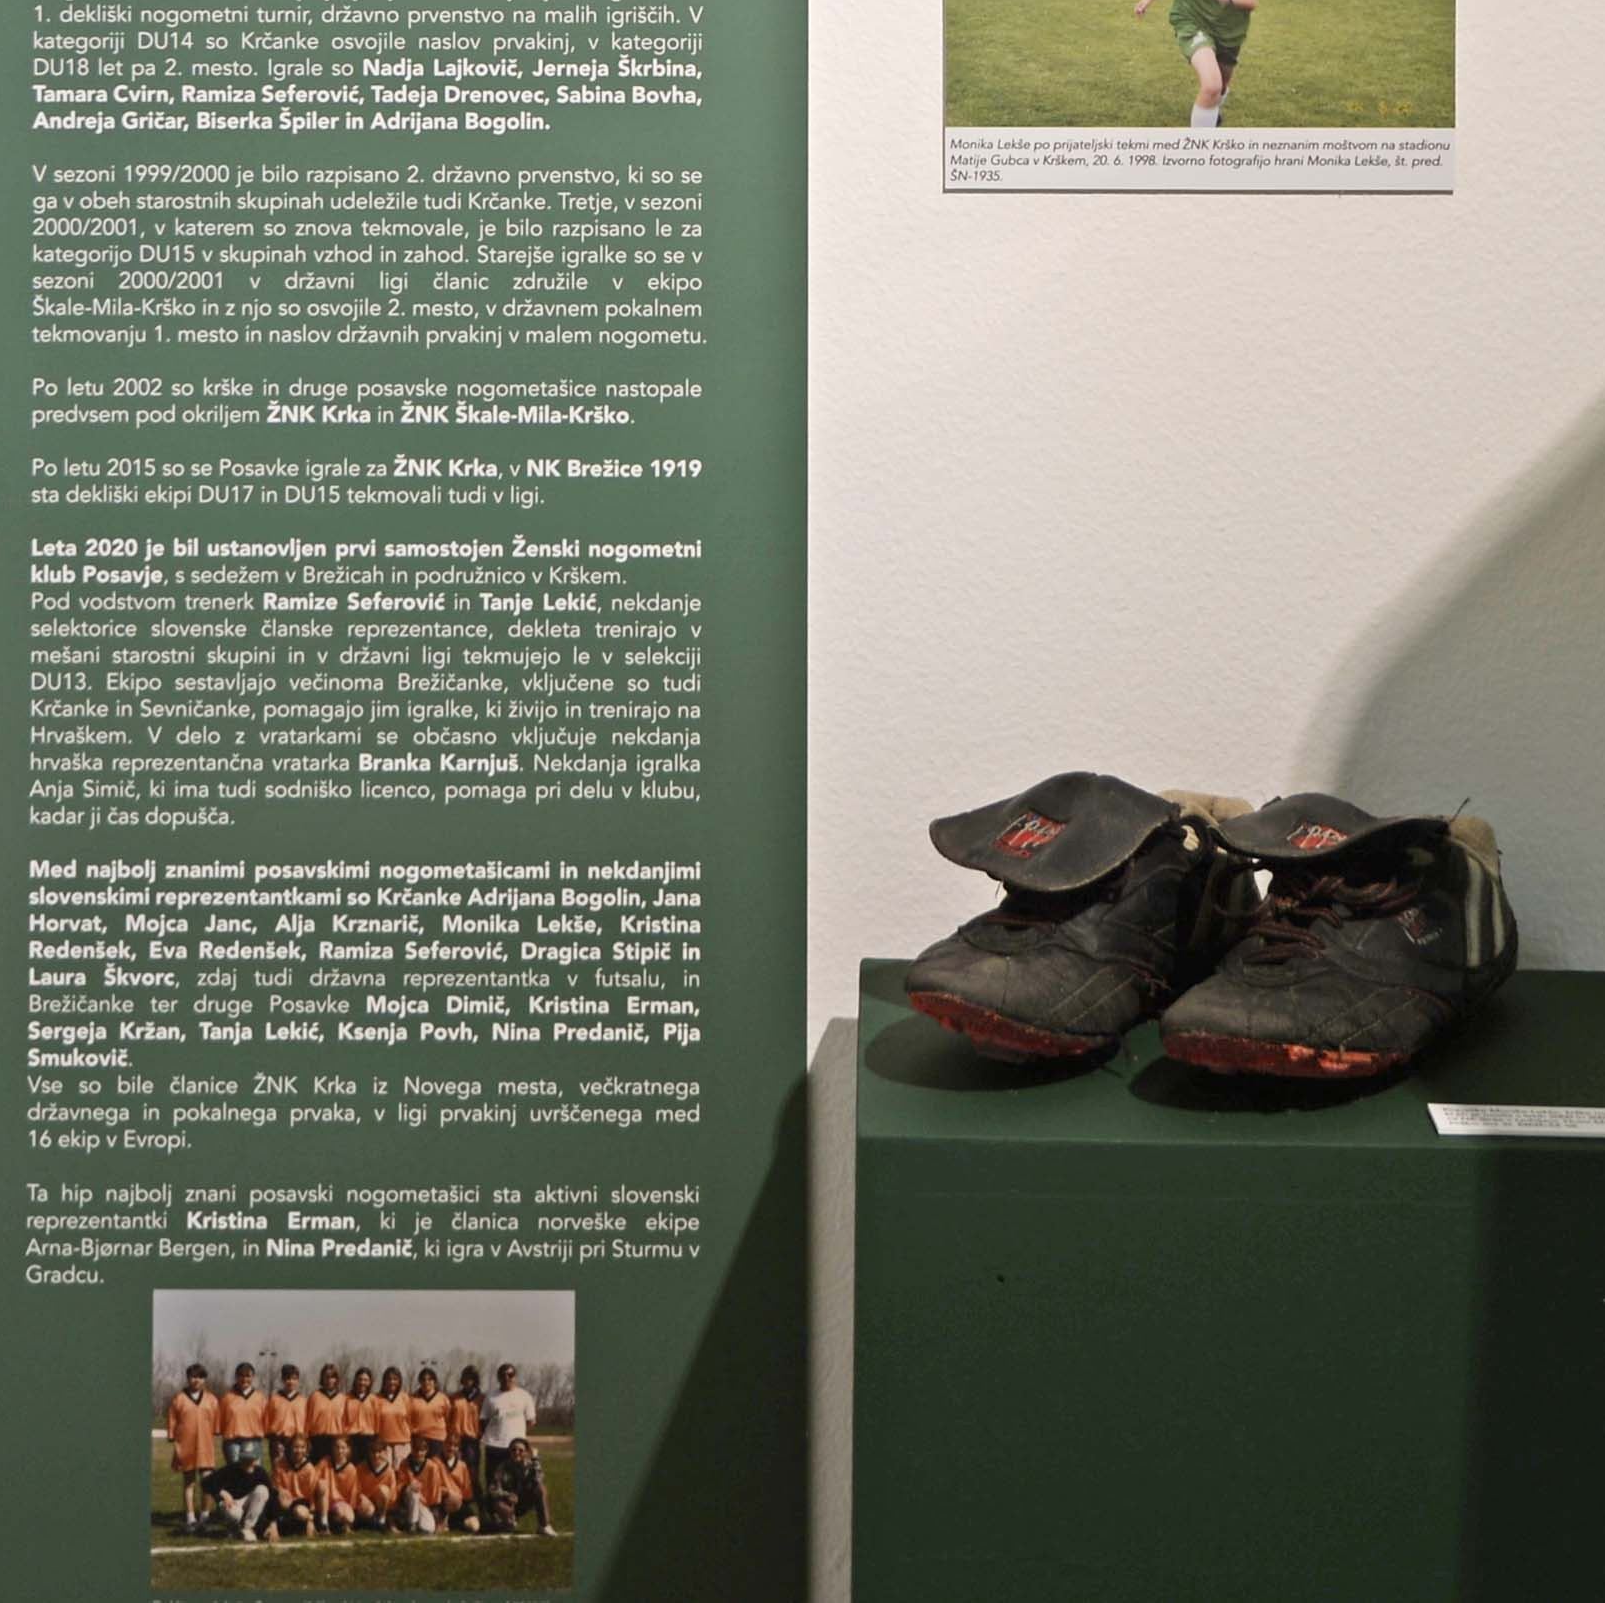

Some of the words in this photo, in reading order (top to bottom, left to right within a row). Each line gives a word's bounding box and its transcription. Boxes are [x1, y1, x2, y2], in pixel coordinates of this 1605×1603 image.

[949, 138, 994, 150] Monika
[997, 138, 1031, 150] Lekše
[1033, 141, 1051, 153] po
[1052, 137, 1114, 153] prijateljski
[1116, 138, 1150, 151] tekmi
[1152, 138, 1181, 151] med
[1182, 136, 1210, 151] ŽNK
[1211, 138, 1246, 151] Krško
[1247, 140, 1260, 151] in
[1261, 139, 1320, 151] neznanim
[1322, 139, 1378, 151] moštvom
[1380, 141, 1396, 151] na
[1397, 138, 1451, 151] stadionu
[949, 154, 988, 170] Matije
[990, 154, 1030, 166] Gubca
[1033, 157, 1040, 166] v
[1162, 154, 1206, 167] Izvorno
[1208, 153, 1272, 170] fotografijo
[1273, 154, 1305, 167] hrani
[1306, 154, 1352, 167] Monika
[32, 457, 58, 477] Po
[64, 457, 101, 477] letu
[106, 457, 156, 477] 2015
[162, 463, 185, 477] so
[190, 463, 213, 477] se
[219, 457, 300, 477] Posavke
[305, 457, 361, 481] igrale
[366, 463, 387, 477] za
[393, 454, 443, 477] ŽNK
[448, 457, 503, 480] Krka,
[509, 464, 521, 477] v
[526, 458, 562, 478] NK
[567, 458, 644, 478] Brežice
[650, 458, 703, 478] 1919
[31, 537, 77, 557] Leta
[84, 537, 139, 557] 2020
[144, 537, 165, 562] je
[173, 537, 199, 557] bil
[206, 537, 327, 563] ustanovljen
[335, 538, 377, 562] prvi
[384, 538, 504, 563] samostojen
[511, 534, 580, 558] Ženski
[588, 539, 702, 564] nogometni
[28, 913, 108, 935] Horvat,
[125, 913, 189, 938] Mojca
[204, 913, 258, 935] Janc,
[274, 912, 316, 938] Alja
[332, 913, 425, 936] Krznarič,
[442, 913, 520, 934] Monika
[536, 913, 603, 936] Lekše,
[620, 914, 701, 934] Kristina
[25, 1237, 154, 1262] Arna-Bjørnar
[158, 1237, 236, 1263] Bergen,
[242, 1238, 260, 1257] in
[266, 1237, 316, 1258] Nina
[321, 1237, 418, 1260] Predanič,
[424, 1237, 440, 1257] ki
[447, 1239, 484, 1263] igra
[490, 1244, 502, 1258] v
[506, 1239, 573, 1263] Avstriji
[579, 1239, 605, 1264] pri
[611, 1238, 683, 1258] Sturmu
[689, 1245, 700, 1258] v
[24, 1263, 105, 1285] Gradcu.
